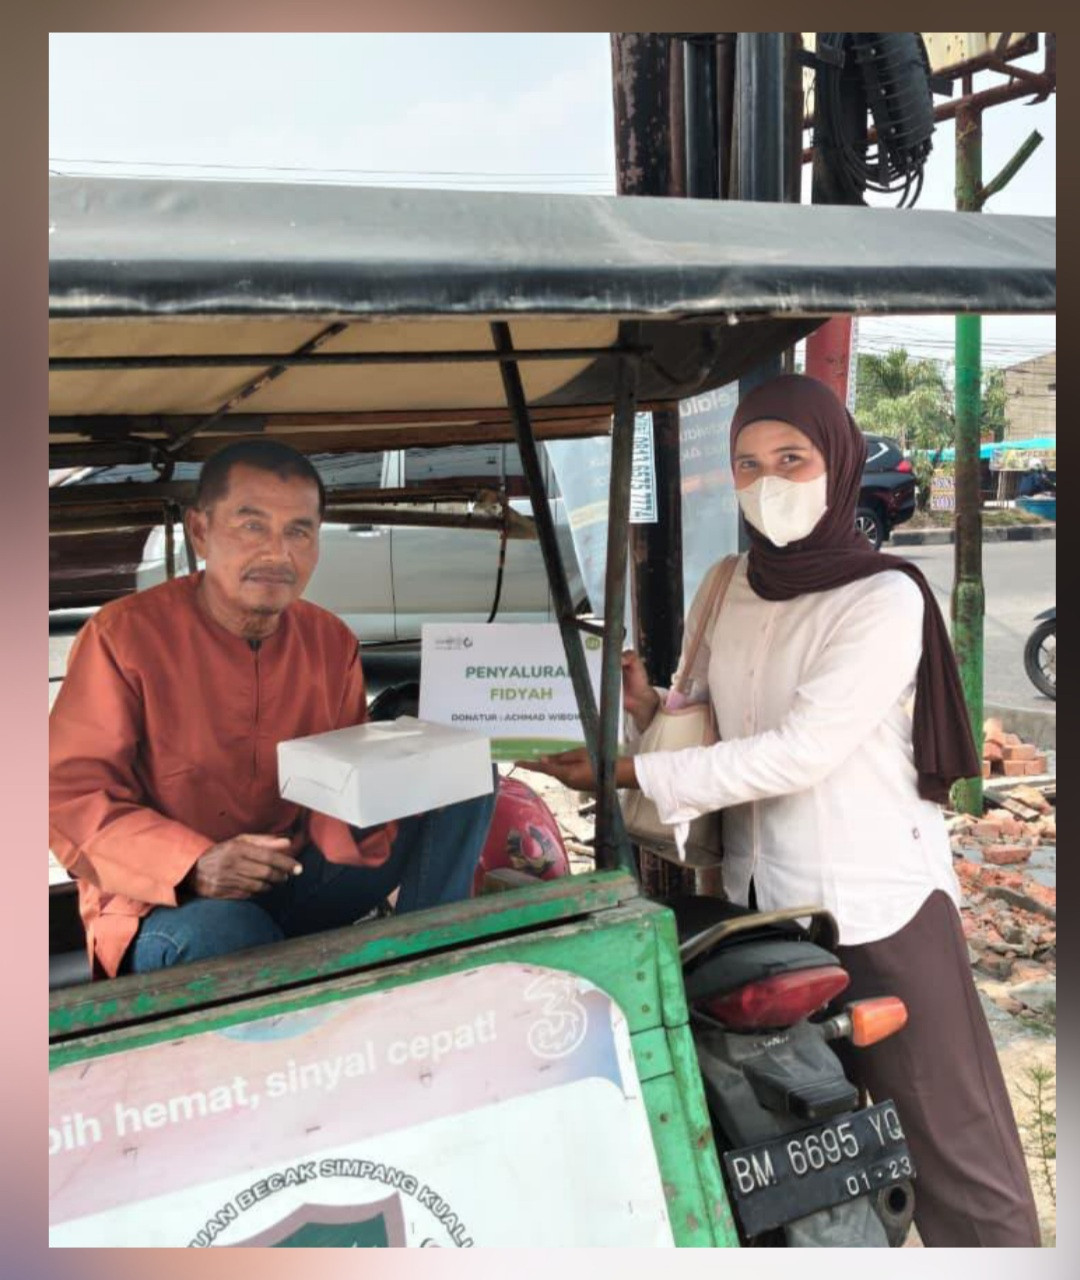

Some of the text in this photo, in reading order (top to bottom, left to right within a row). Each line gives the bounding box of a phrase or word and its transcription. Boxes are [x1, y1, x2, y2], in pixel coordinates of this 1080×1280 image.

[451, 713, 497, 721] DONATUR
[504, 713, 546, 721] ACHMAD
[548, 713, 581, 721] WIBOW
[490, 687, 553, 701] FIDYAH
[114, 1074, 261, 1136] hemat,
[265, 1040, 376, 1099] sinyal
[387, 1010, 498, 1063] cepat!
[732, 1108, 905, 1194] BM 6695 YQ
[235, 1161, 317, 1211] BECAK
[319, 1159, 418, 1196] SIMPANG
